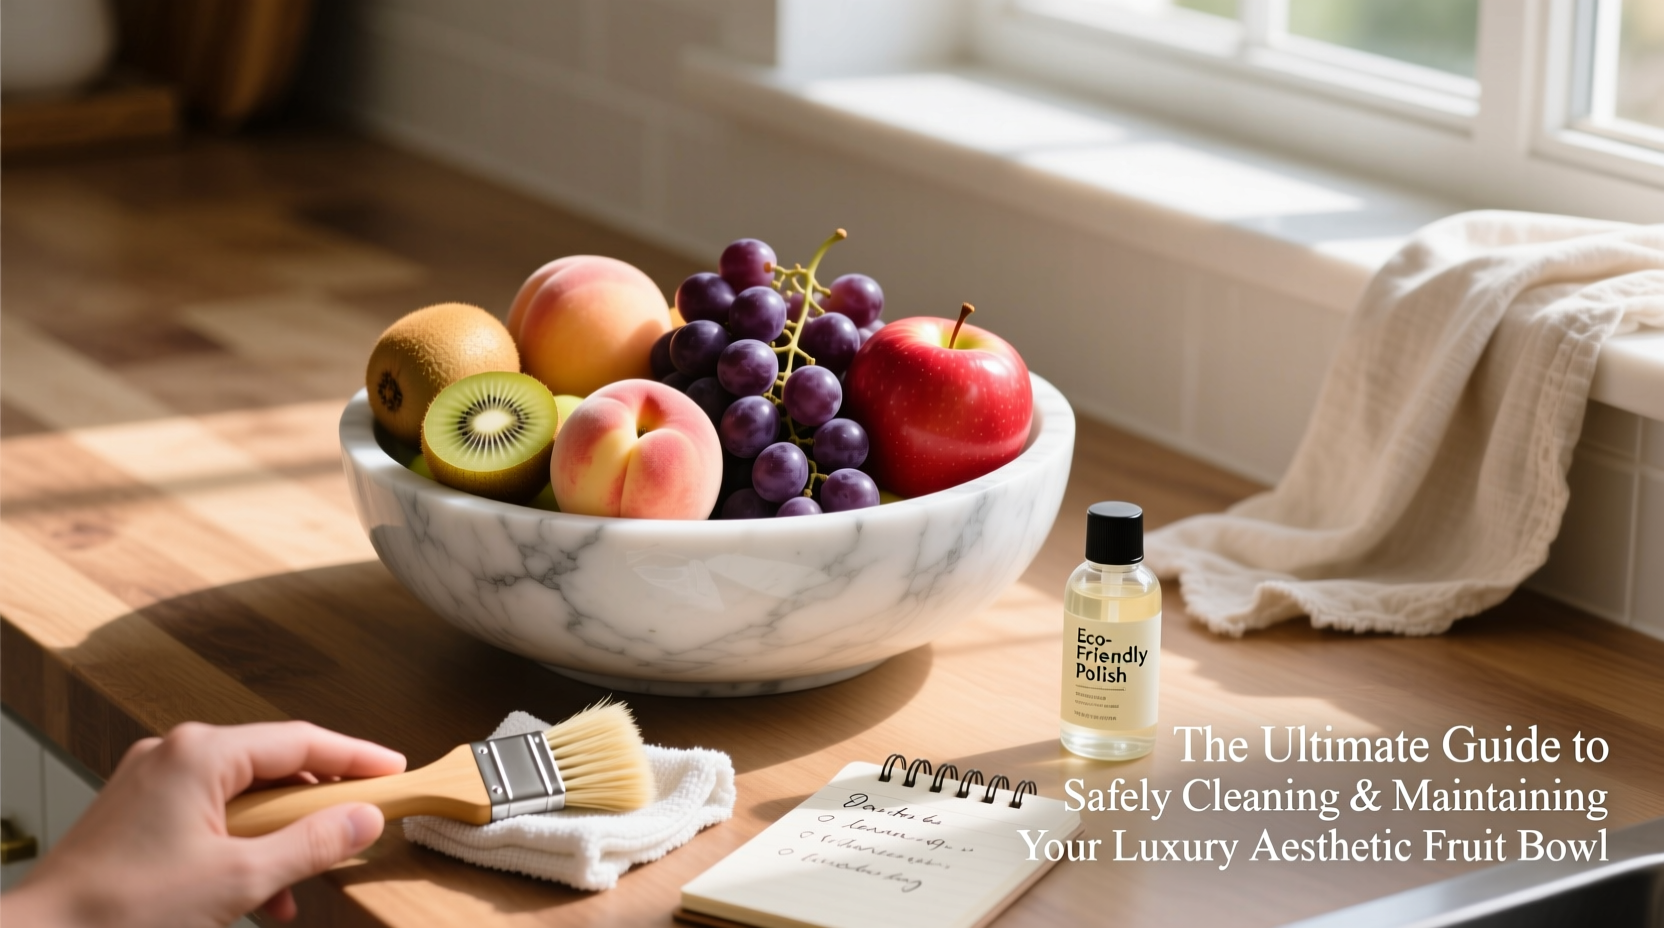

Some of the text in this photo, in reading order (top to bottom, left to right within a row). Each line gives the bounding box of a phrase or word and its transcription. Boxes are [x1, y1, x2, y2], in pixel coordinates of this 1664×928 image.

[1077, 627, 1112, 646] Eco-
[1076, 645, 1149, 667] Friendly
[1075, 662, 1127, 683] Polish
